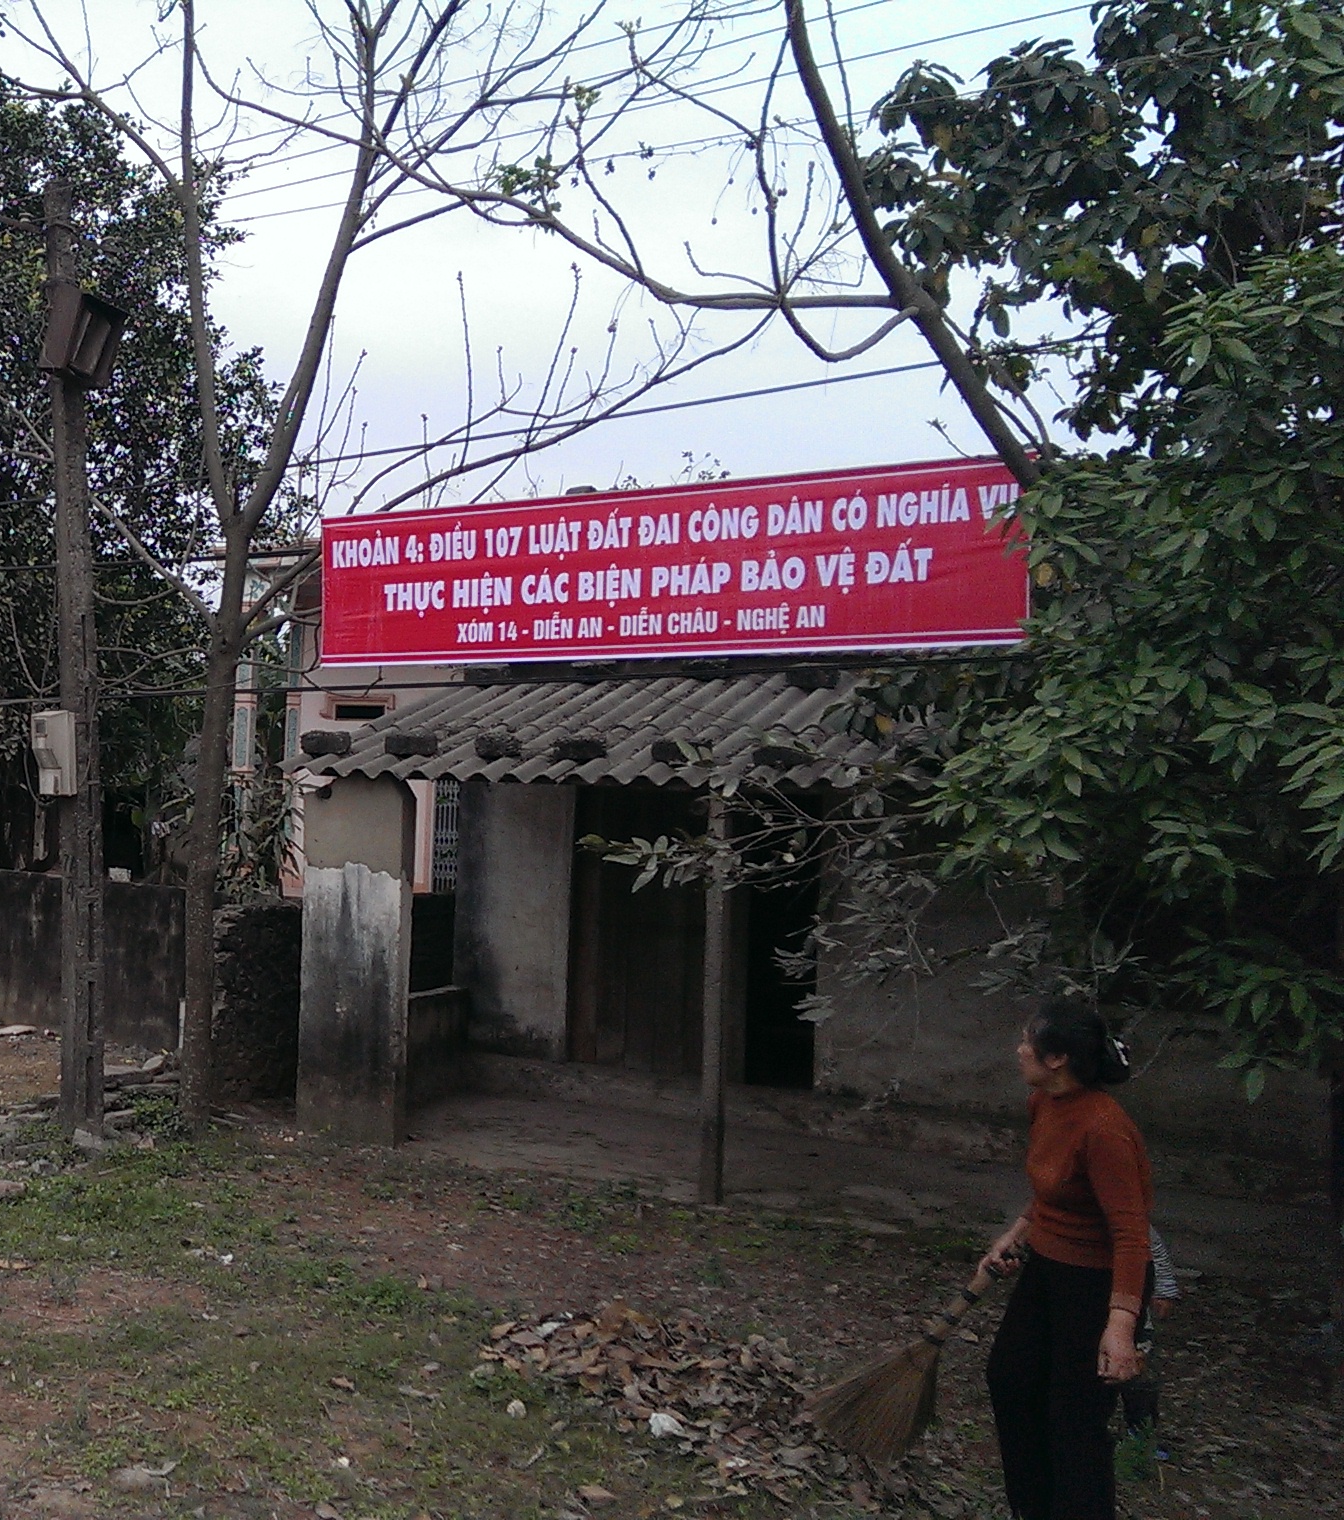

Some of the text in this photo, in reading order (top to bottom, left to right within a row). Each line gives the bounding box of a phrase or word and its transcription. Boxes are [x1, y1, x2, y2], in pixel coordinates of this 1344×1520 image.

[332, 529, 400, 569] KHOẢN
[405, 534, 424, 563] 4:
[430, 521, 477, 562] ĐIỀU
[485, 526, 523, 558] 107
[529, 516, 582, 560] LUẬT
[588, 508, 632, 549] ĐẤT
[639, 512, 681, 546] ĐAI
[688, 502, 759, 543] CÔNG
[767, 496, 823, 536] DÂN
[832, 489, 867, 531] CÓ
[383, 538, 934, 618] THỰC HIỆN CÁC BIỆN PHÁP BẢO VỆ ĐẤT
[457, 620, 493, 643] XÓM
[498, 623, 517, 641] 14
[533, 611, 573, 640] DIỄN
[578, 617, 603, 638] AN
[619, 607, 662, 636] DIỄN
[667, 607, 718, 634] CHÂU
[737, 602, 790, 634] NGHỆ
[796, 605, 826, 628] AN
